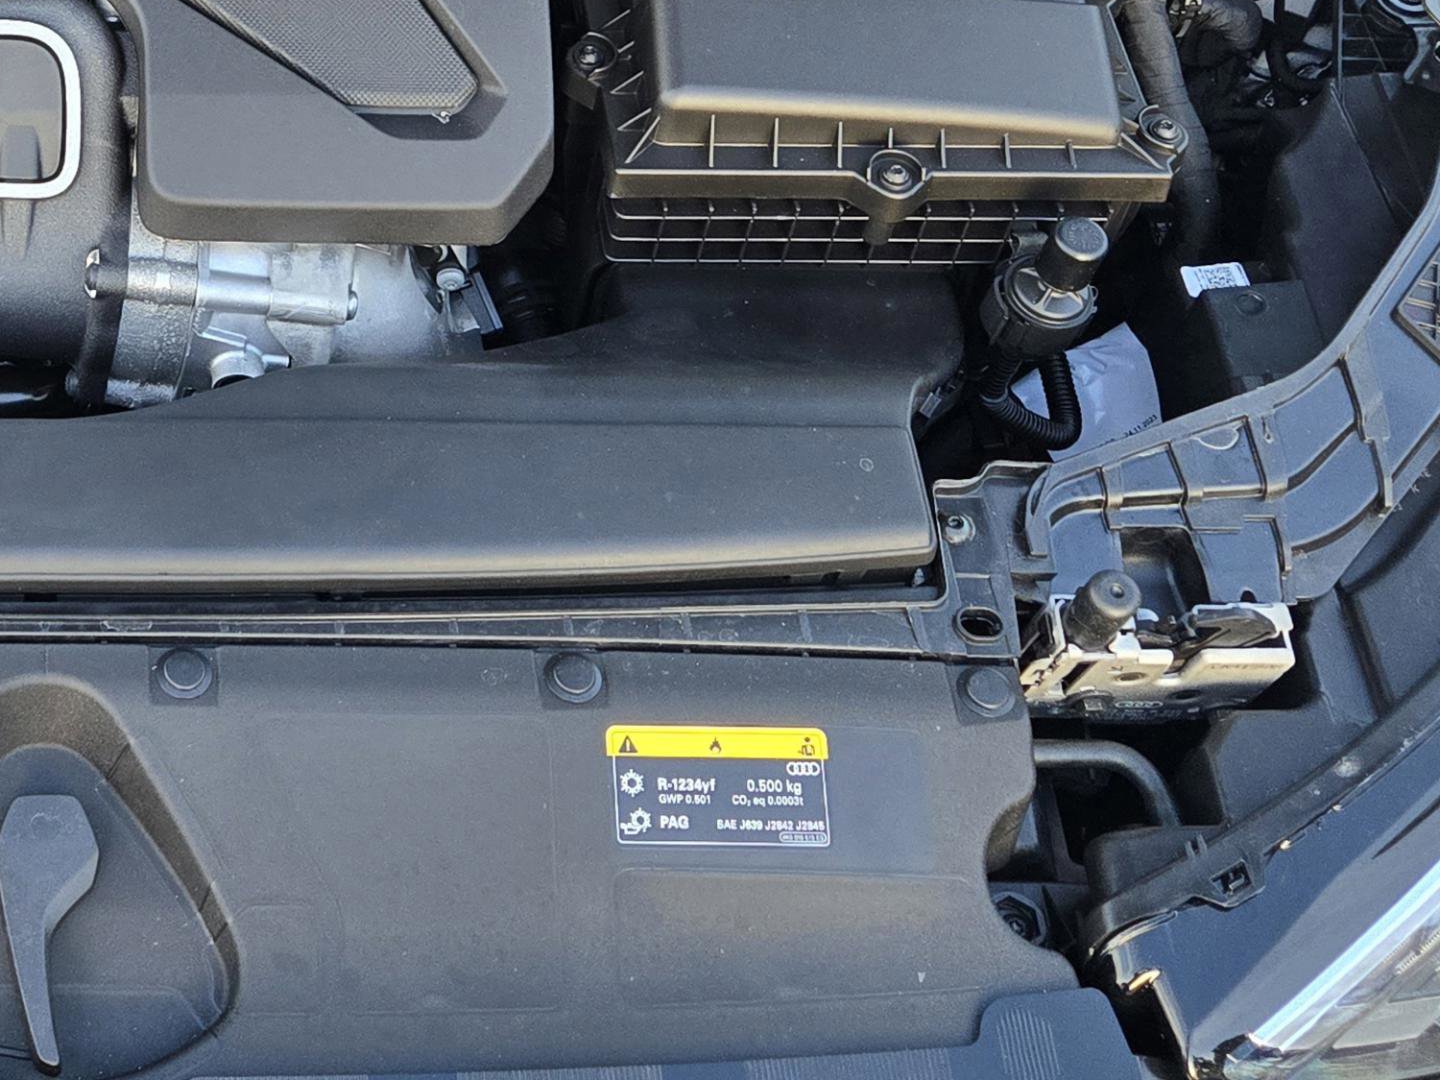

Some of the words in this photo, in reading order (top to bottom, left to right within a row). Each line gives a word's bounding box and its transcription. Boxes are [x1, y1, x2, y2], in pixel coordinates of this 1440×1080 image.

[657, 777, 716, 794] R-1234yf
[746, 779, 783, 793] 0.500
[786, 779, 802, 796] kg
[658, 793, 684, 804] GWP
[685, 794, 711, 805] 0.501
[752, 796, 766, 808] eq
[767, 795, 804, 807] 0.0003t
[660, 814, 689, 830] PAG
[739, 819, 763, 831] J639
